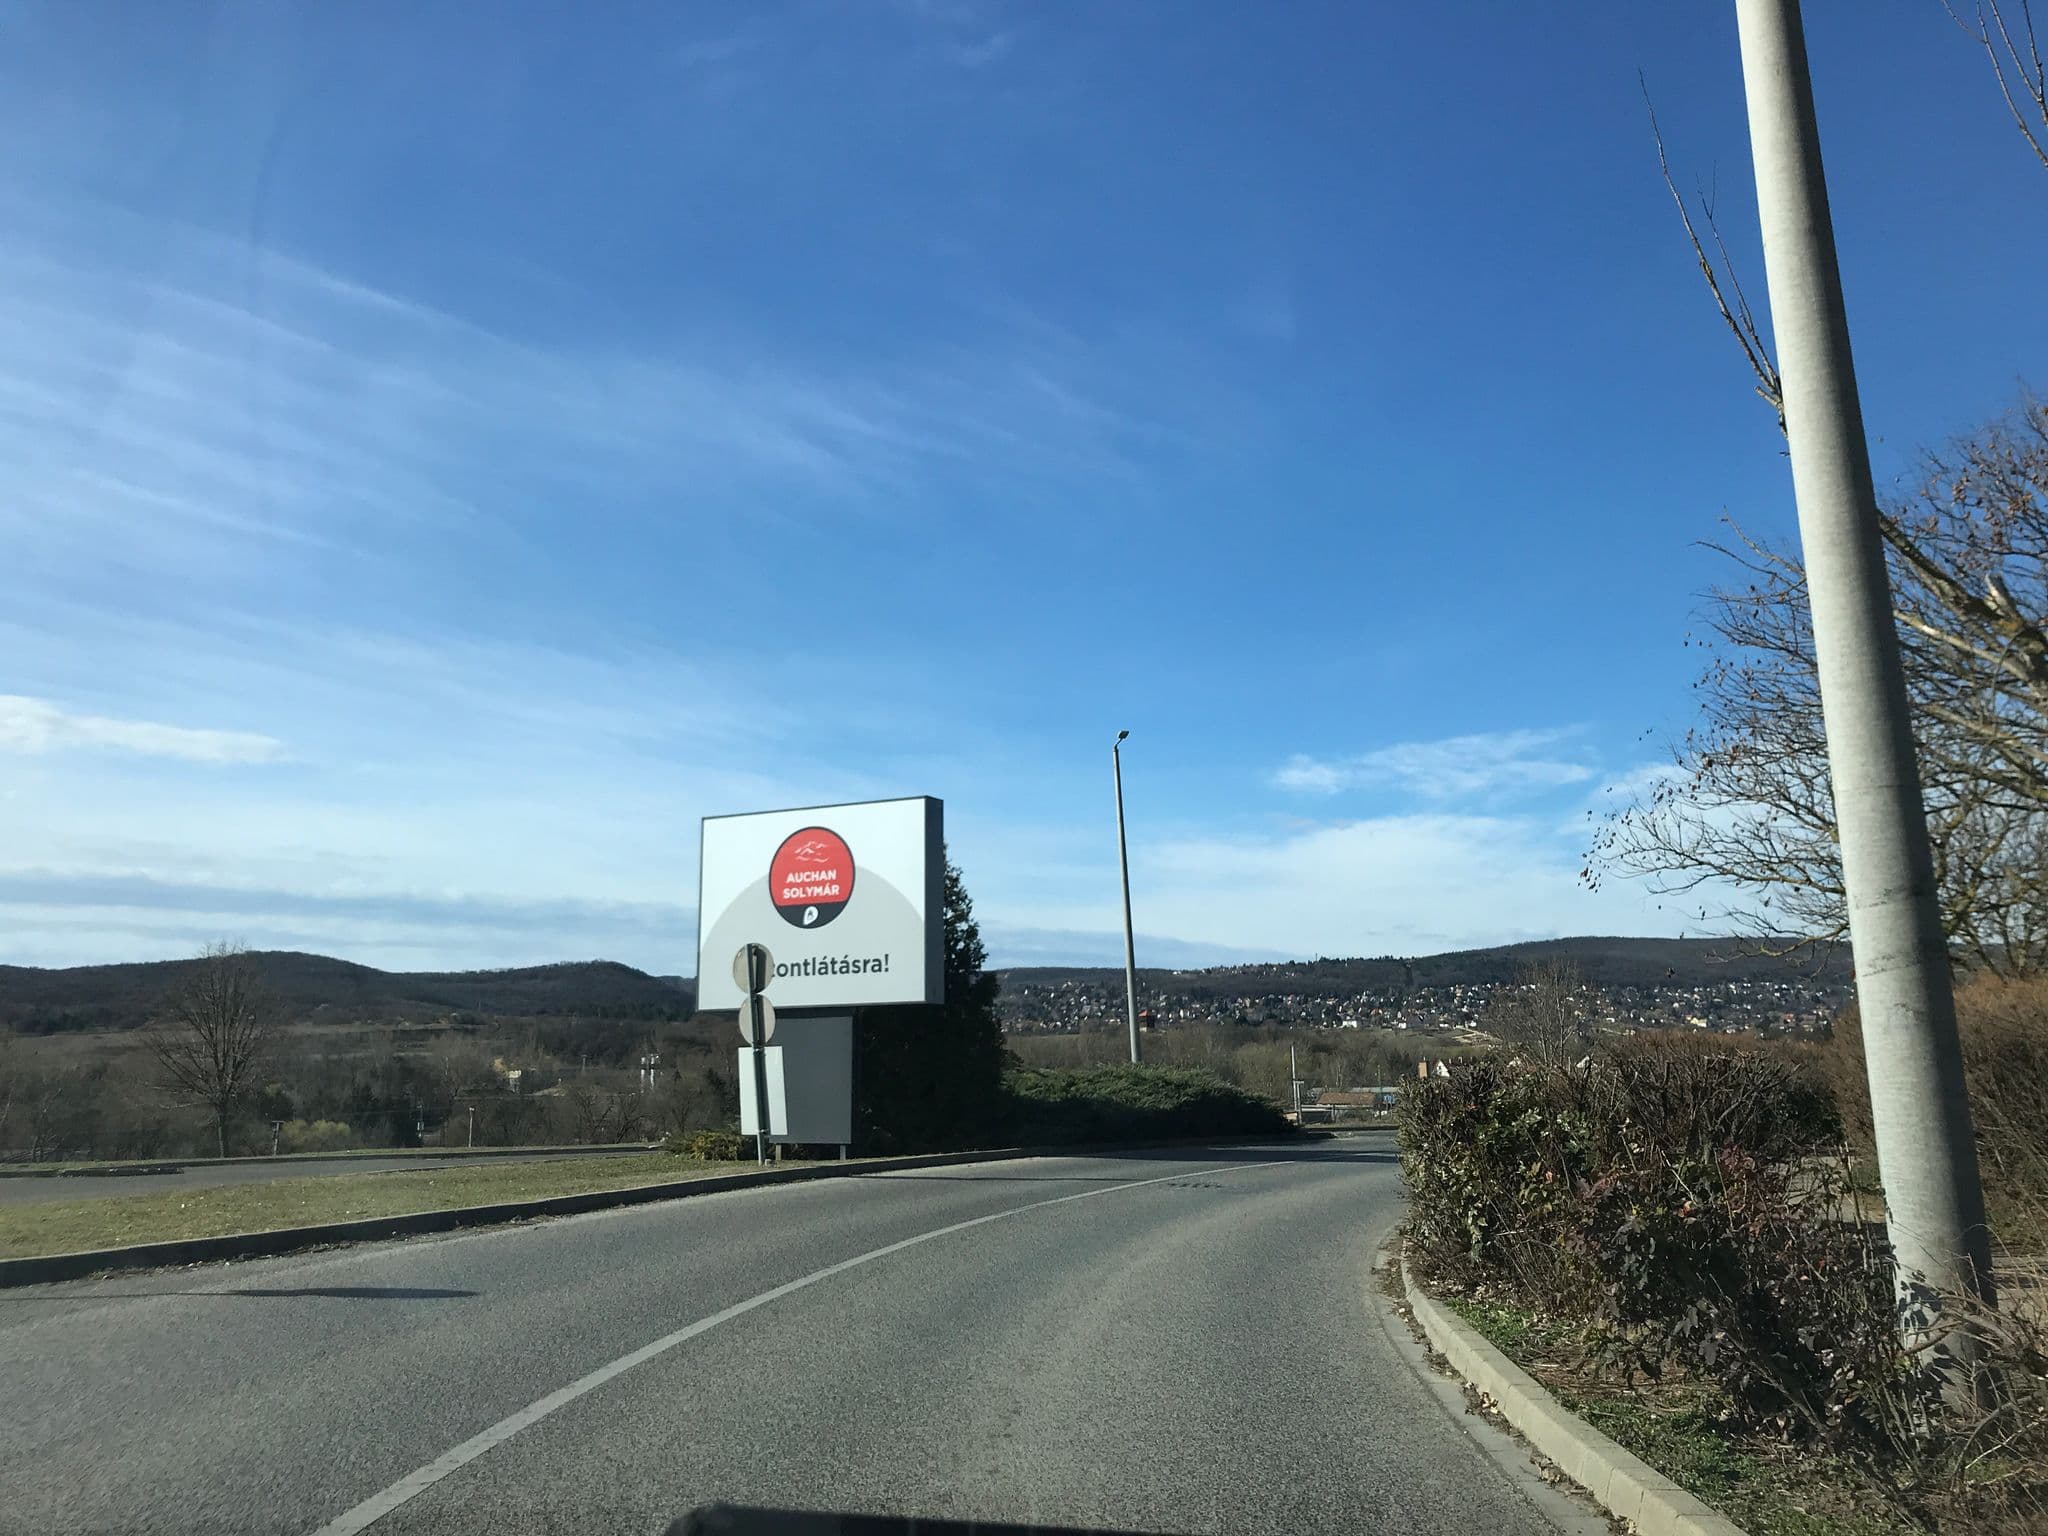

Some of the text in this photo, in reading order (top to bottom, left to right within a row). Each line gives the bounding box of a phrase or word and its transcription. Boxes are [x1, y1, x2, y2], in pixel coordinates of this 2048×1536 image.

[786, 870, 837, 883] AUCHAN
[783, 883, 840, 899] SOLYMÁR
[772, 953, 889, 978] ontlátásra!
